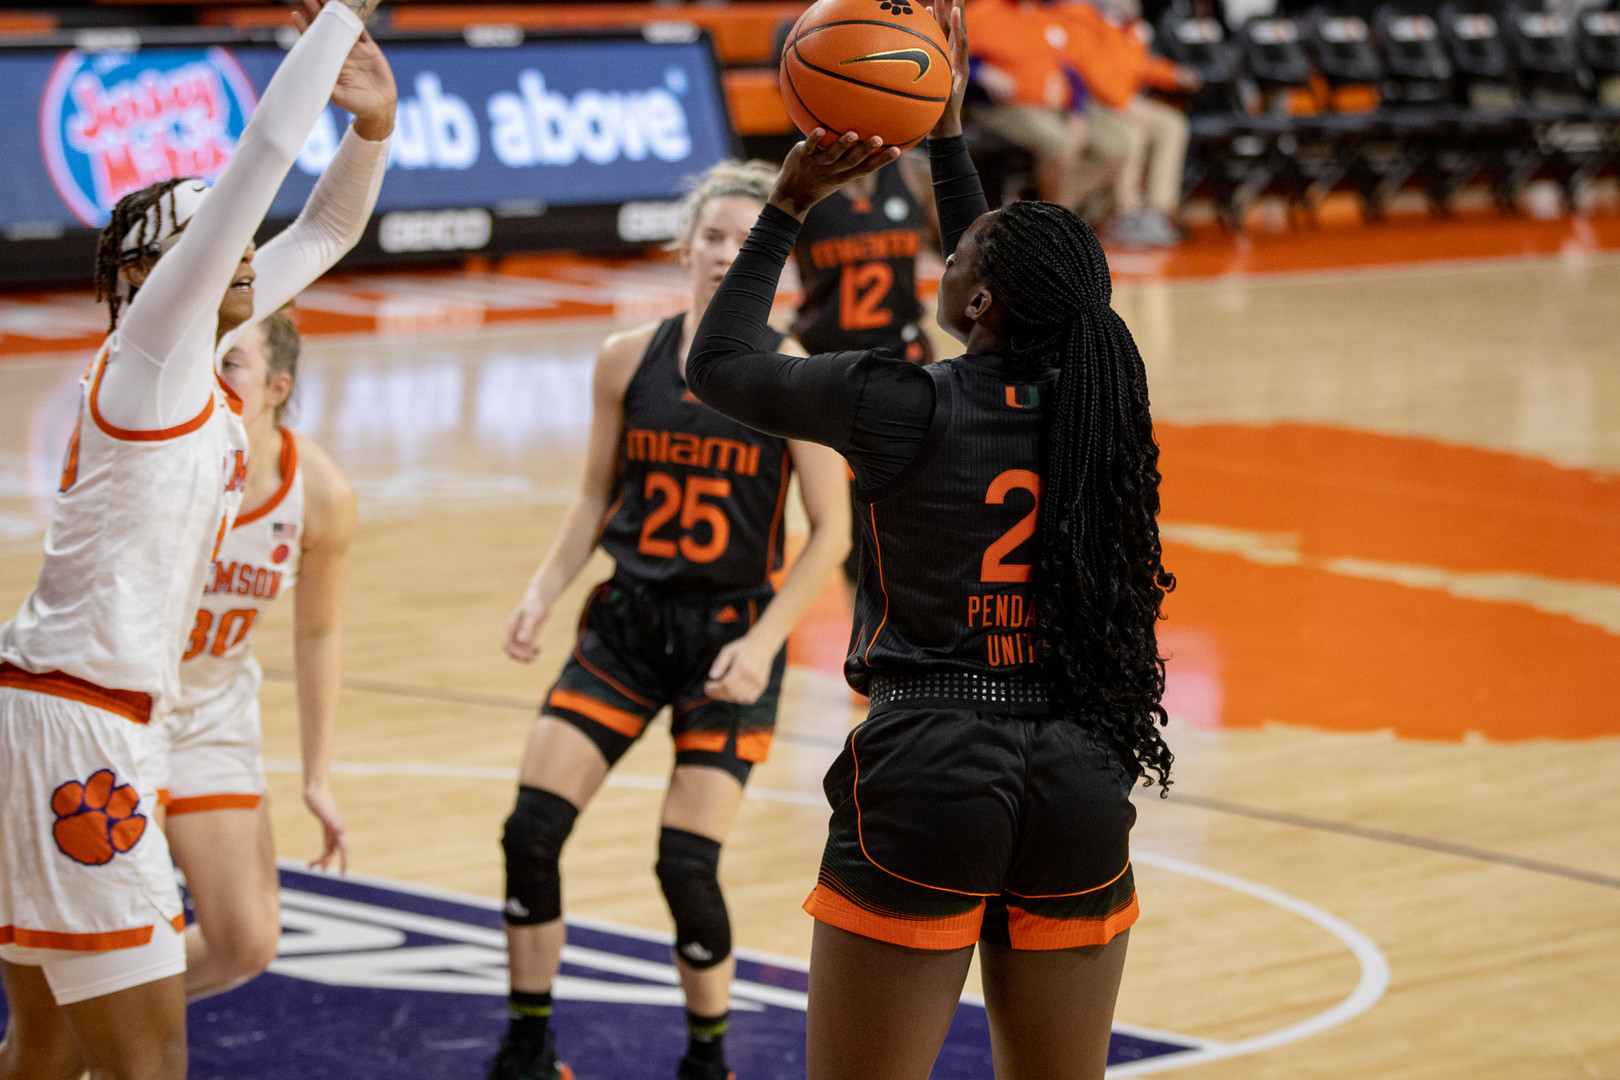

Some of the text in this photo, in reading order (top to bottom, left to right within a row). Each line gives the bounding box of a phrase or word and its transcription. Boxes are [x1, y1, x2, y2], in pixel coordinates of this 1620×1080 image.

[348, 71, 481, 171] ub
[487, 68, 692, 168] above
[839, 262, 894, 330] 12
[638, 471, 732, 564] 25
[980, 469, 1045, 583] 2
[181, 609, 258, 660] 30
